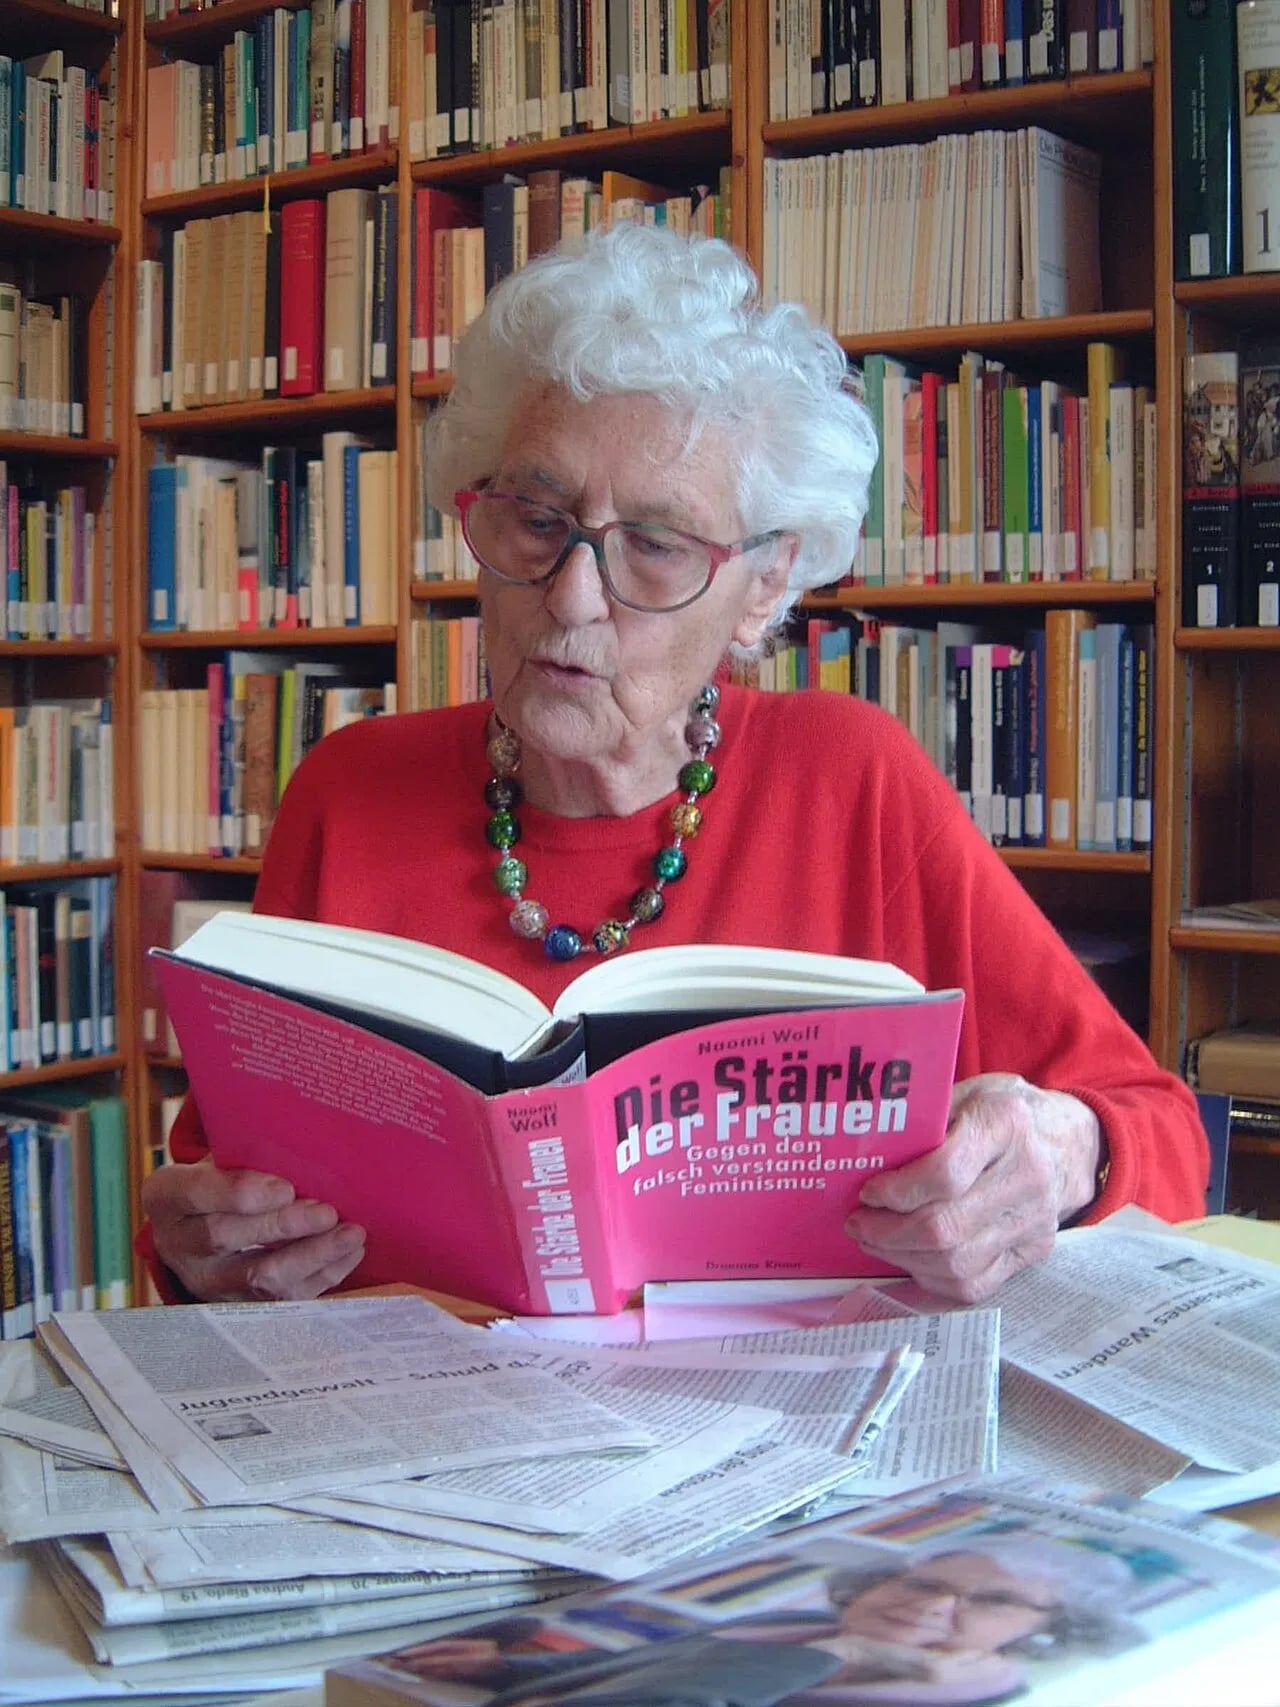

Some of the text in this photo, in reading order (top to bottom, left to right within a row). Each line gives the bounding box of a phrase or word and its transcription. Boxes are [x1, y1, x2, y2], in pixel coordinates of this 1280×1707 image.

[1257, 208, 1271, 254] 1
[1205, 563, 1213, 575] 1
[1266, 560, 1274, 573] 2
[698, 1025, 820, 1055] Naomi Wolf
[614, 1046, 911, 1145] Die Stärke
[510, 1112, 557, 1133] Wolf
[615, 1090, 907, 1174] der Frauen
[687, 1137, 821, 1163] Gegen den
[633, 1155, 884, 1196] falsch verstandenen
[681, 1175, 826, 1197] Feminismus
[1054, 1325, 1158, 1380] Wandern
[178, 1378, 377, 1411] Jugendgewalt
[408, 1361, 499, 1381] Schuld
